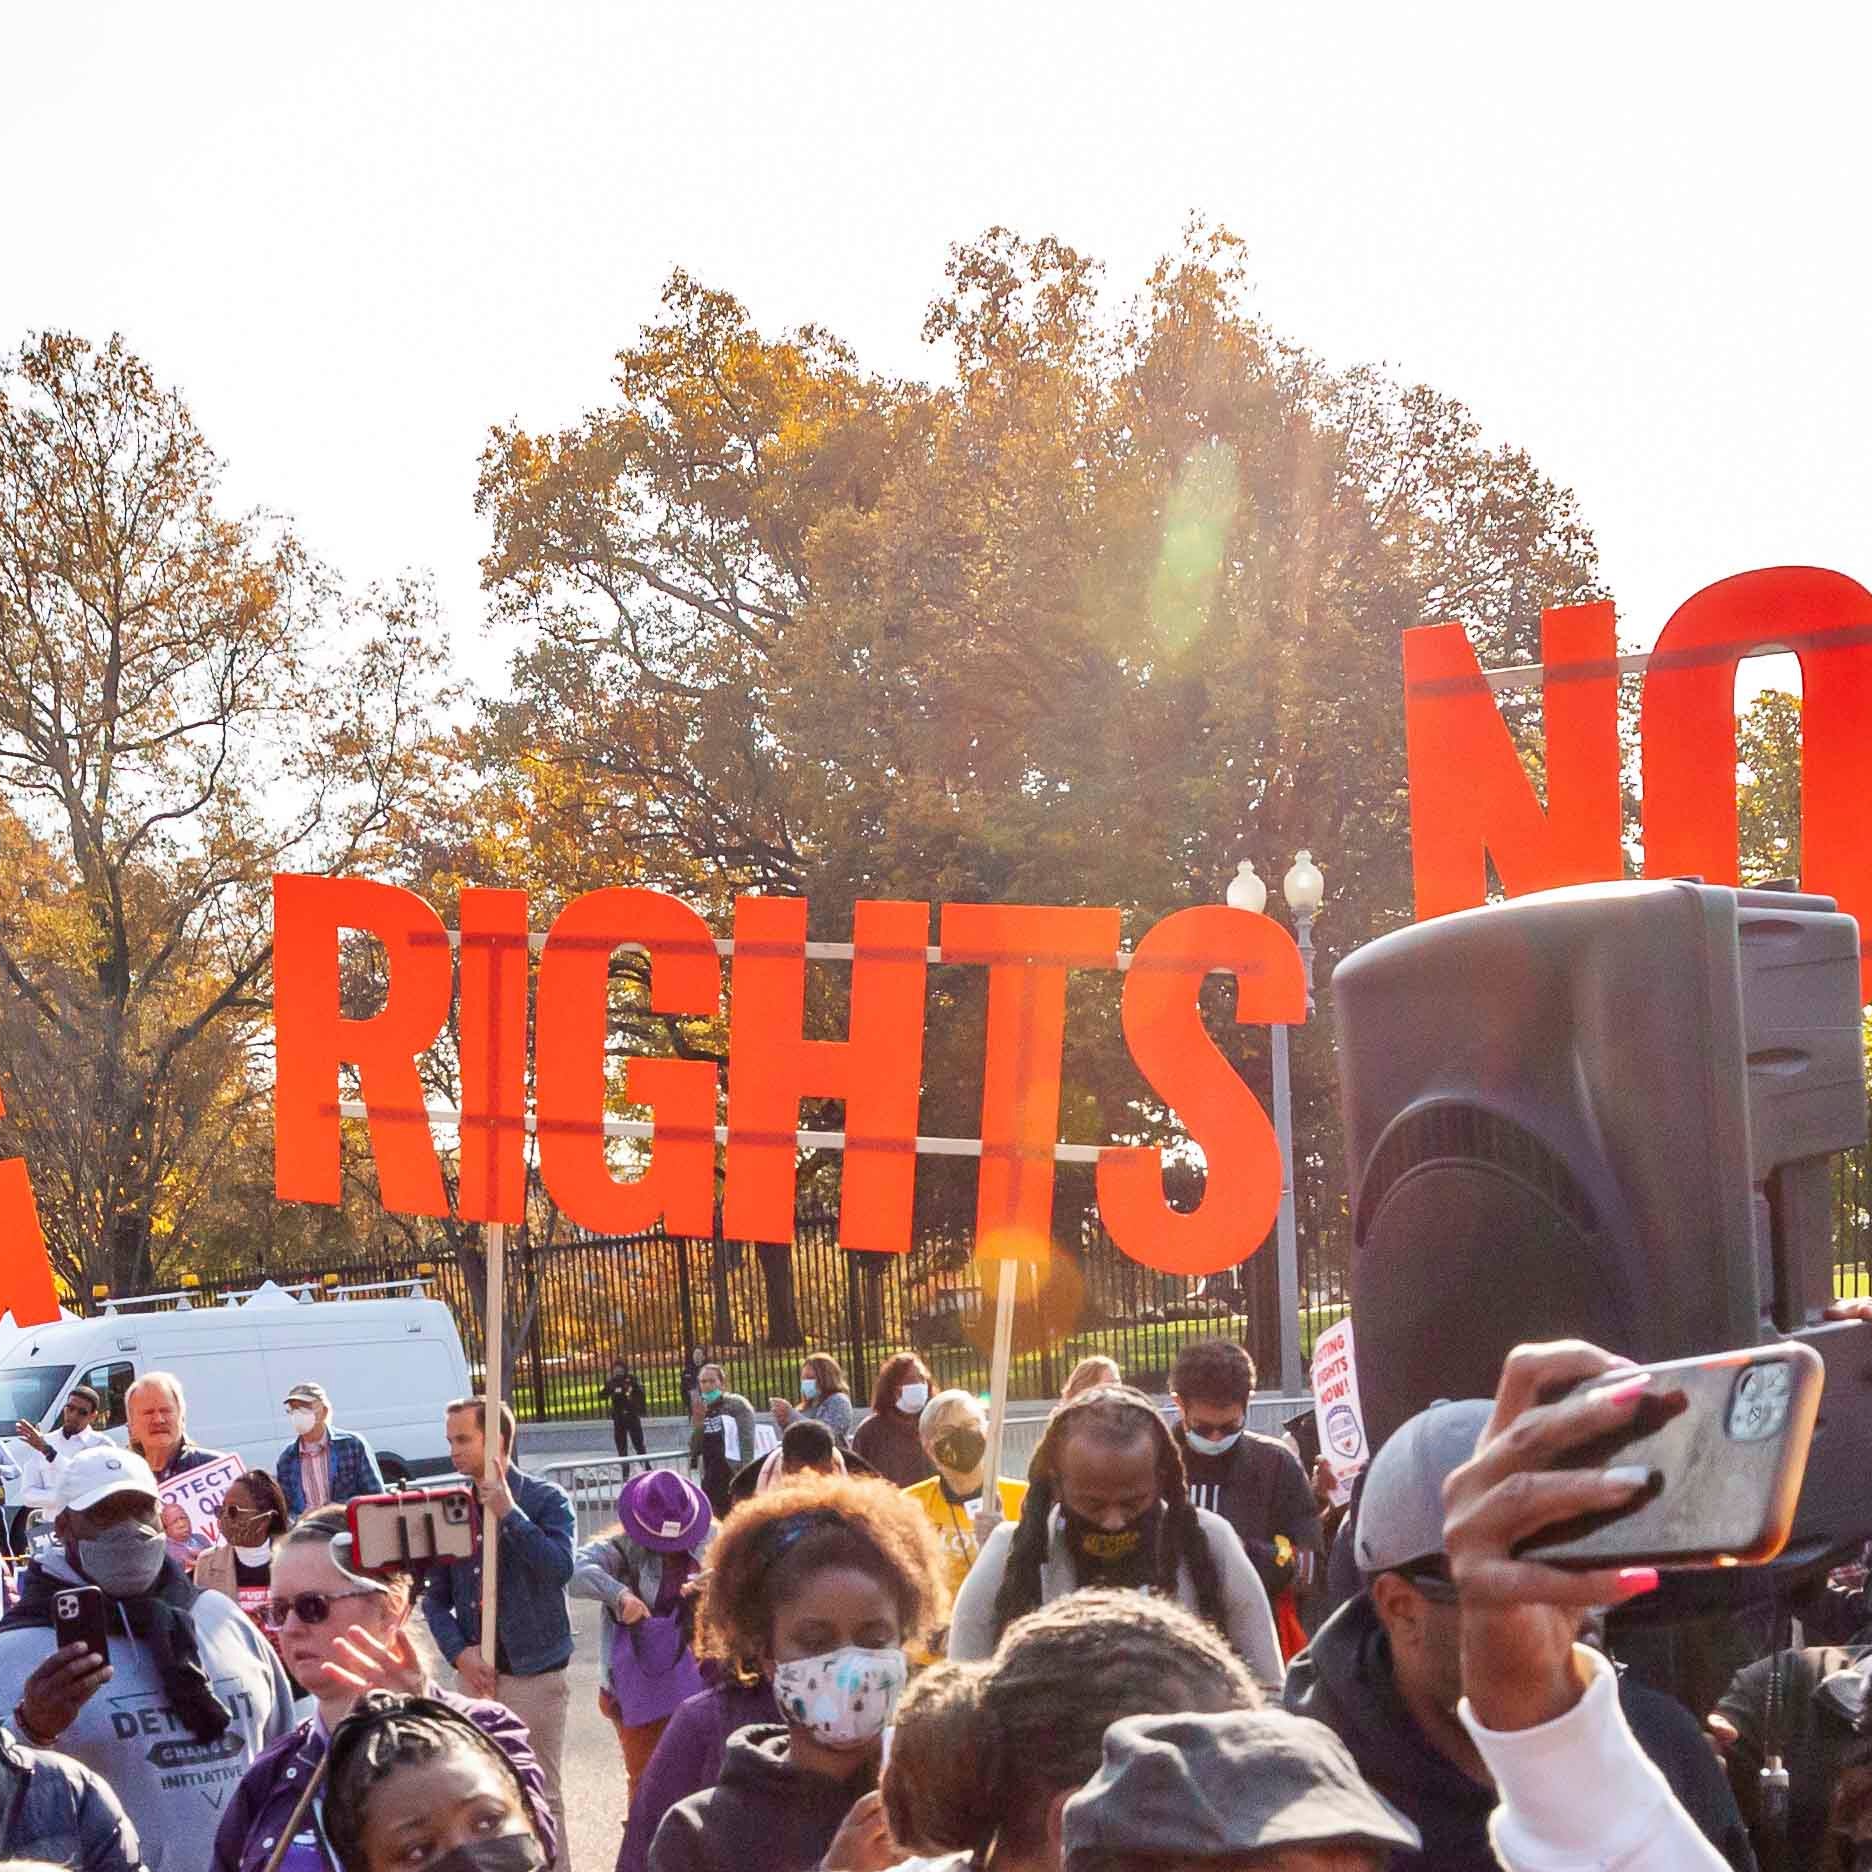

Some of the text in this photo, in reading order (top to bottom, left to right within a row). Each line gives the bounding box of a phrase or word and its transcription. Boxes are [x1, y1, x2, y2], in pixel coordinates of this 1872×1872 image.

[273, 872, 1306, 1276] RIGHTS
[111, 1692, 254, 1740] DETIT
[161, 1765, 243, 1790] INITIATIVE
